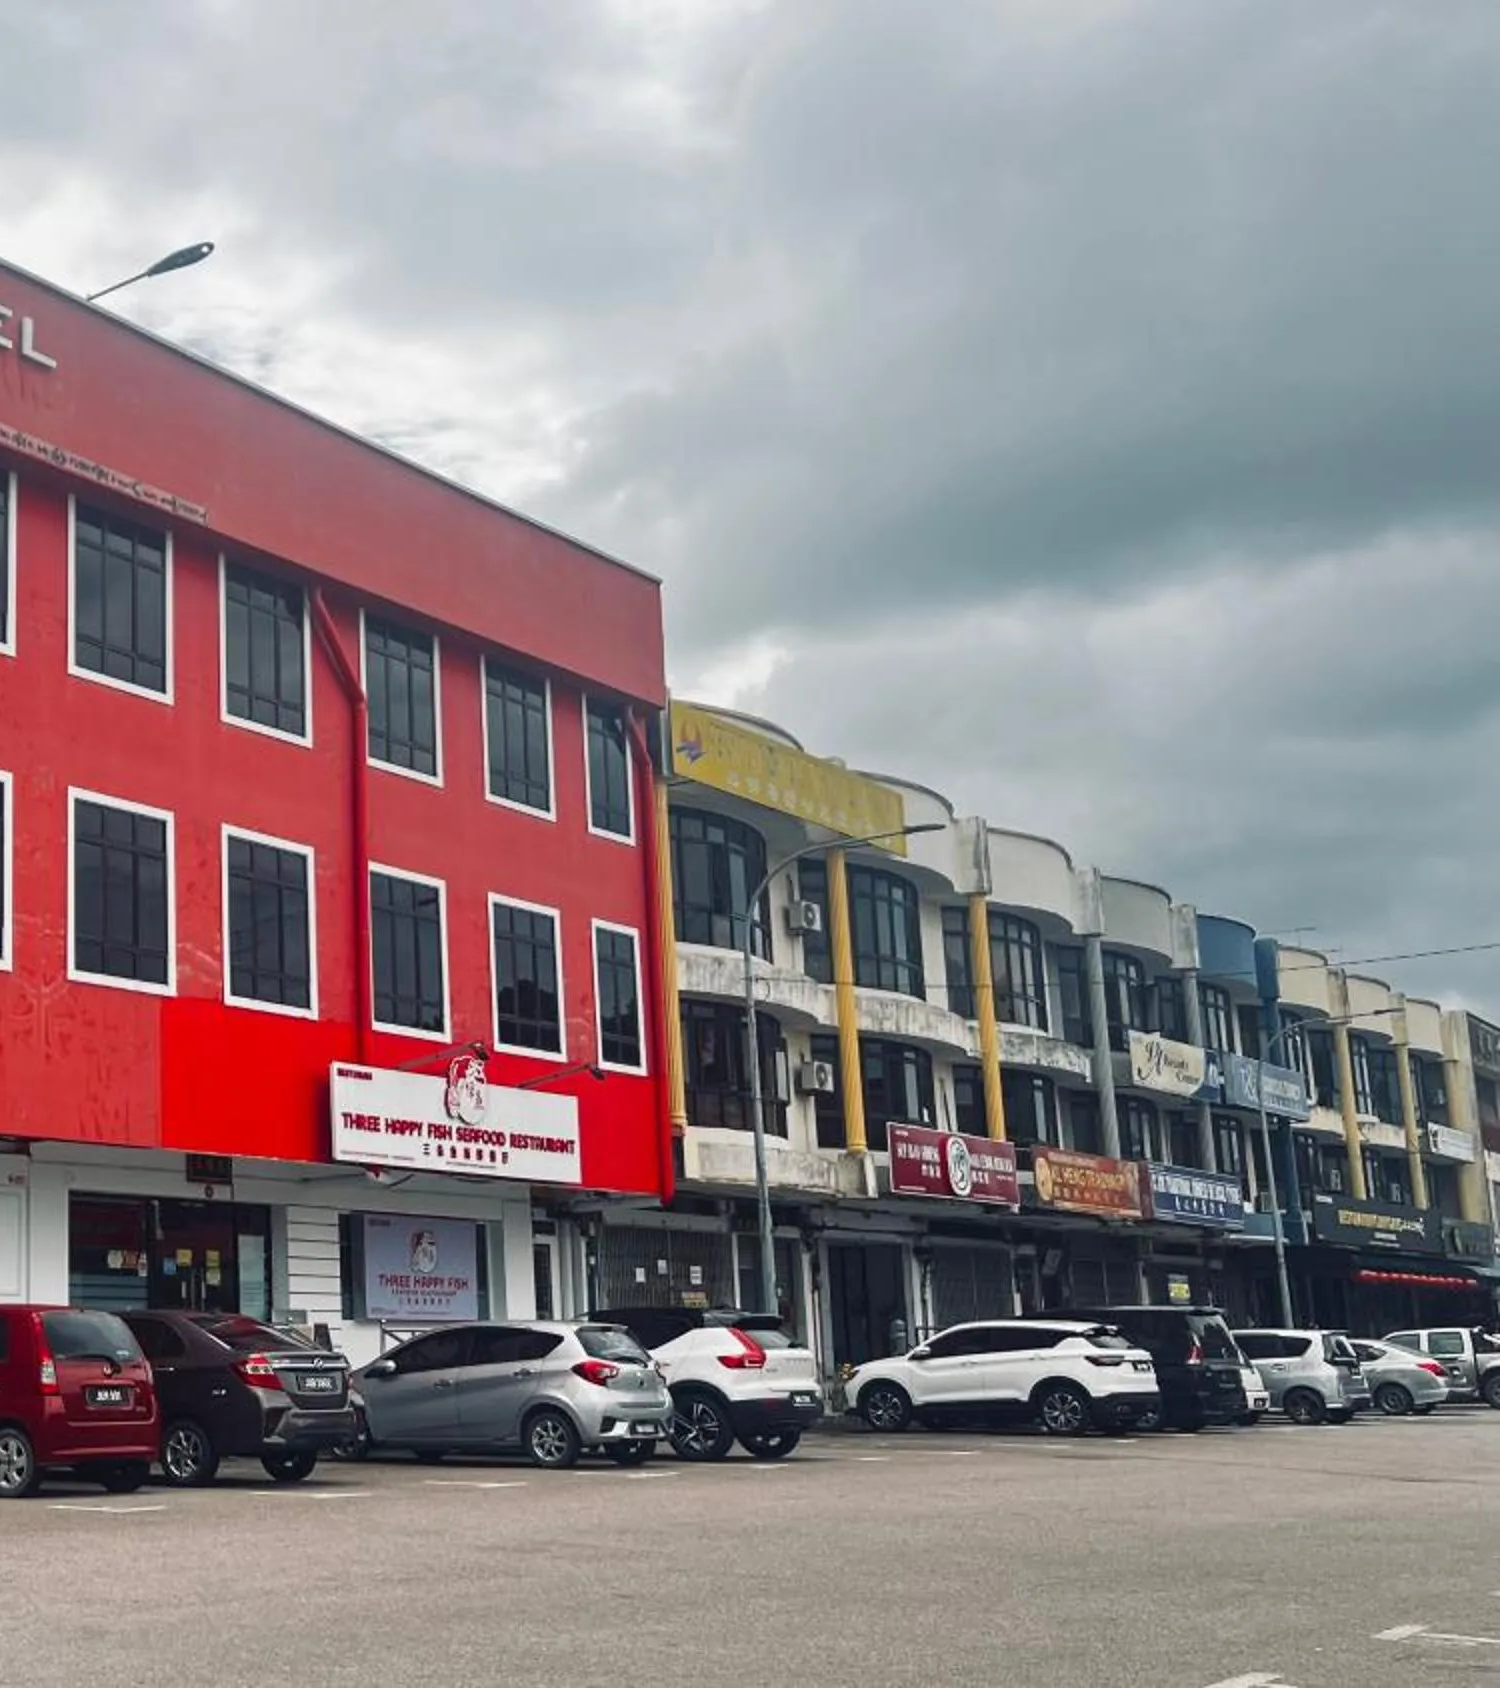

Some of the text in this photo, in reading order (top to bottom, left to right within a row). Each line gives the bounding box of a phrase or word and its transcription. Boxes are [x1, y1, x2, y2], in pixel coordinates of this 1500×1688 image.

[341, 1112, 381, 1134] THREE
[384, 1115, 423, 1137] HAPPY
[427, 1122, 453, 1142] FISH
[455, 1127, 507, 1148] SEAFOOD
[509, 1134, 575, 1155] RESTAURANT
[379, 1273, 469, 1291] THREE HAPPY FISH
